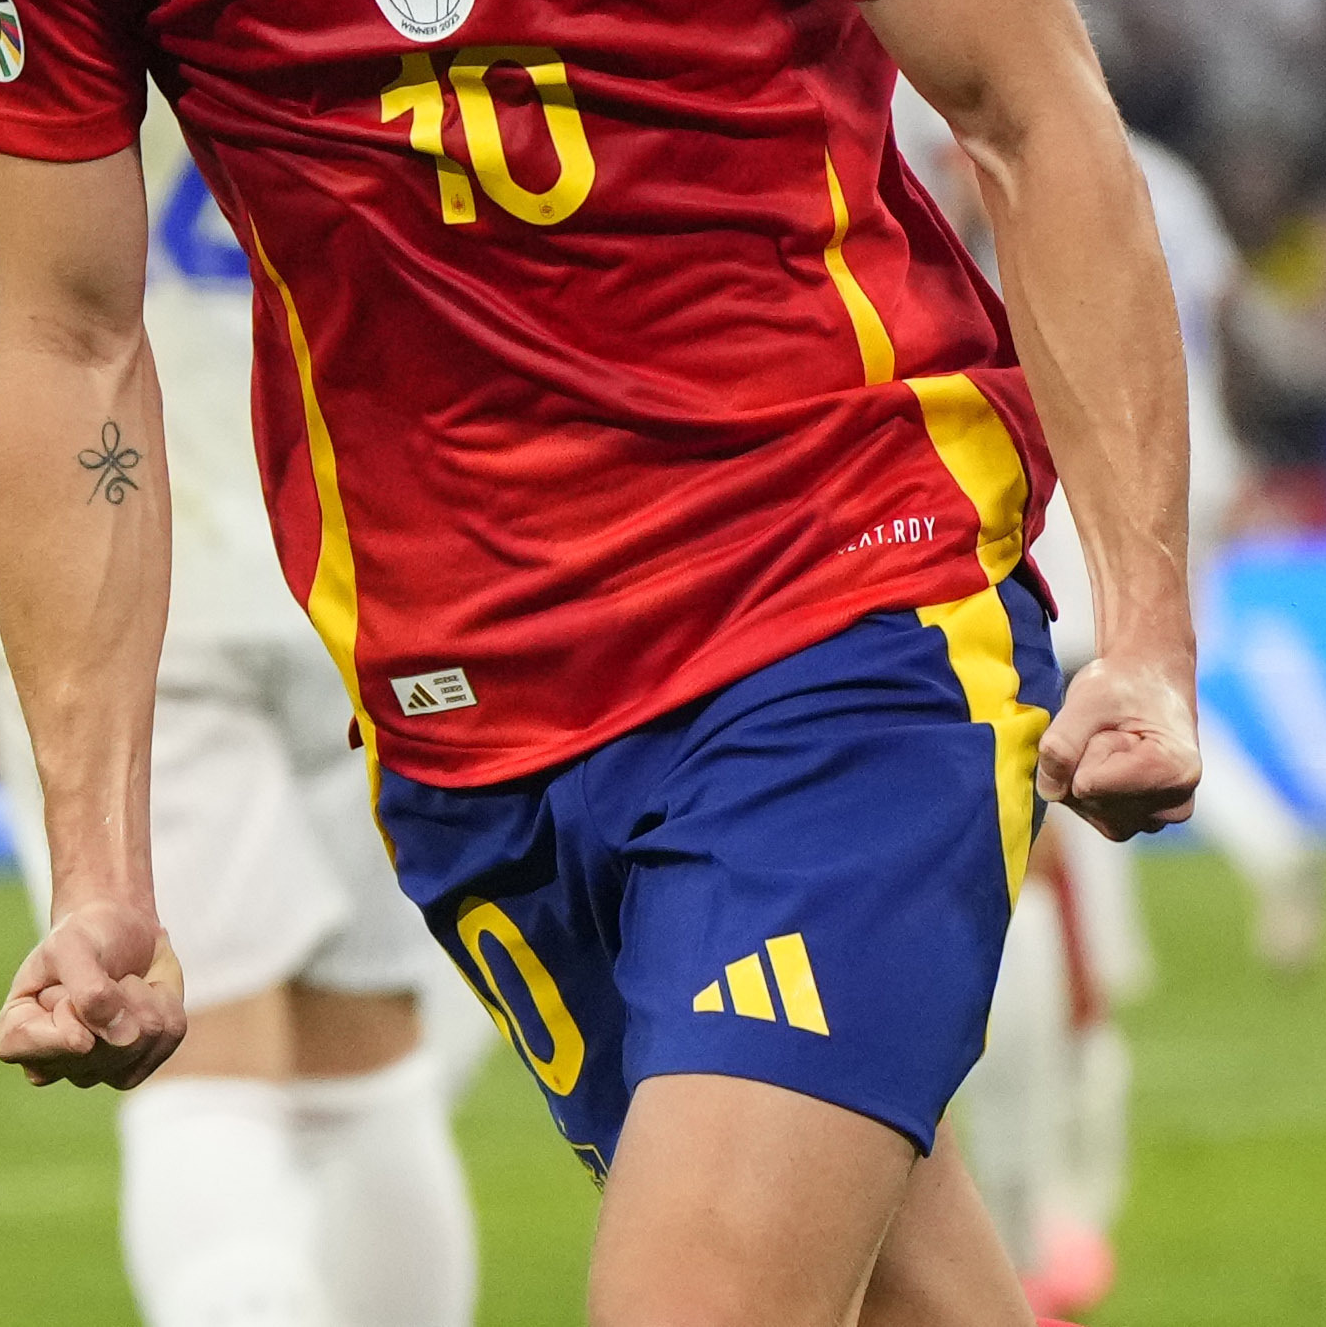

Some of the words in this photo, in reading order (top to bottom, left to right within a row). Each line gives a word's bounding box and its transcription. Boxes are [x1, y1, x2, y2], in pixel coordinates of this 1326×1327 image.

[401, 19, 438, 35] WINNER
[380, 45, 596, 226] 10
[838, 516, 936, 555] AT.RDY
[457, 896, 585, 1096] 0
